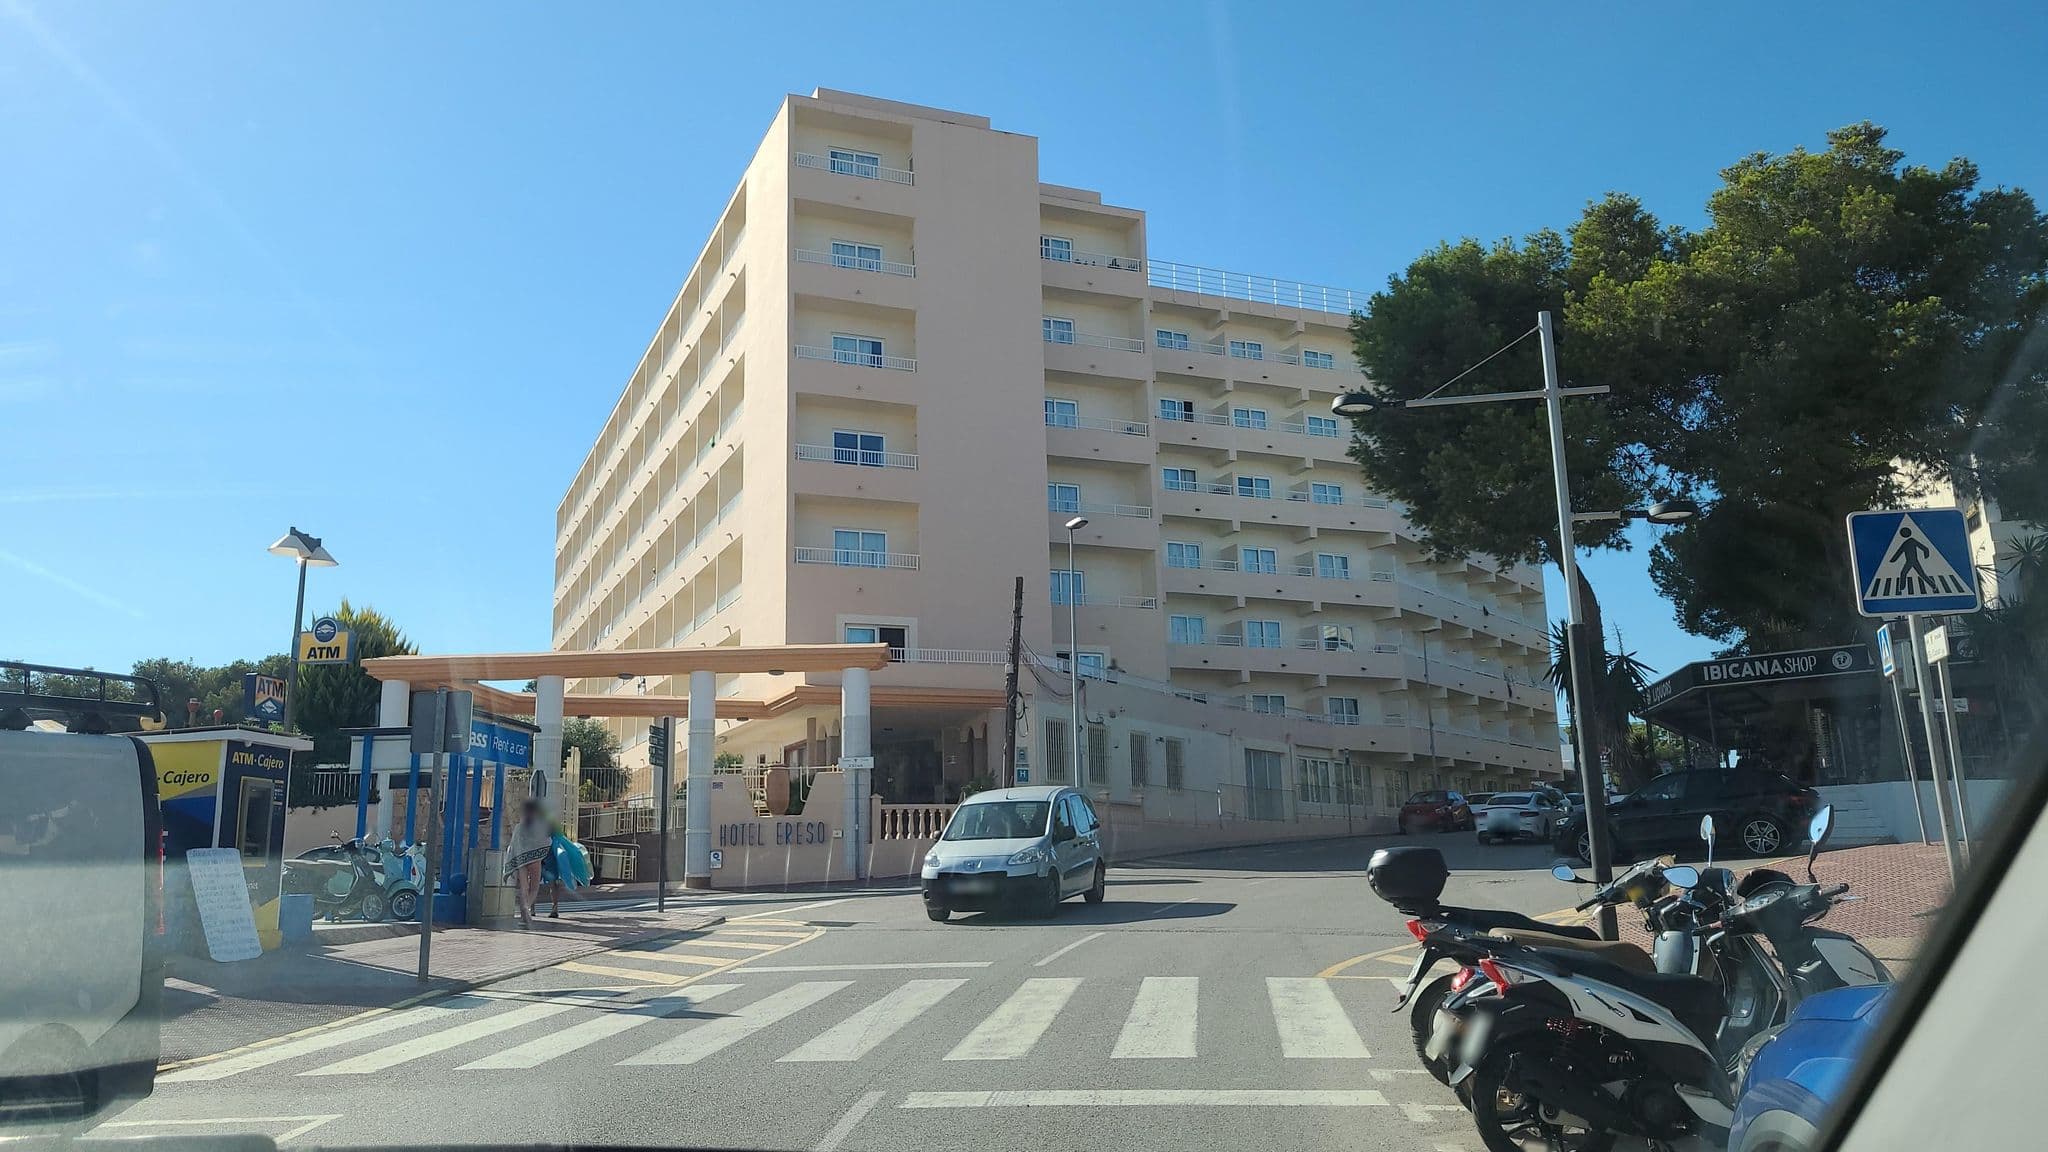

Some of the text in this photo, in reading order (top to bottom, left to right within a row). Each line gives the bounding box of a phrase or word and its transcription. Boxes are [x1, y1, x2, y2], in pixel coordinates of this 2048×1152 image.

[307, 646, 340, 659] ATM
[1703, 655, 1817, 681] IBICANA SHOP
[257, 677, 284, 698] ATM
[492, 736, 509, 752] Rent
[509, 743, 515, 753] a
[515, 744, 527, 755] car
[719, 821, 826, 847] HOTEL ERESO
